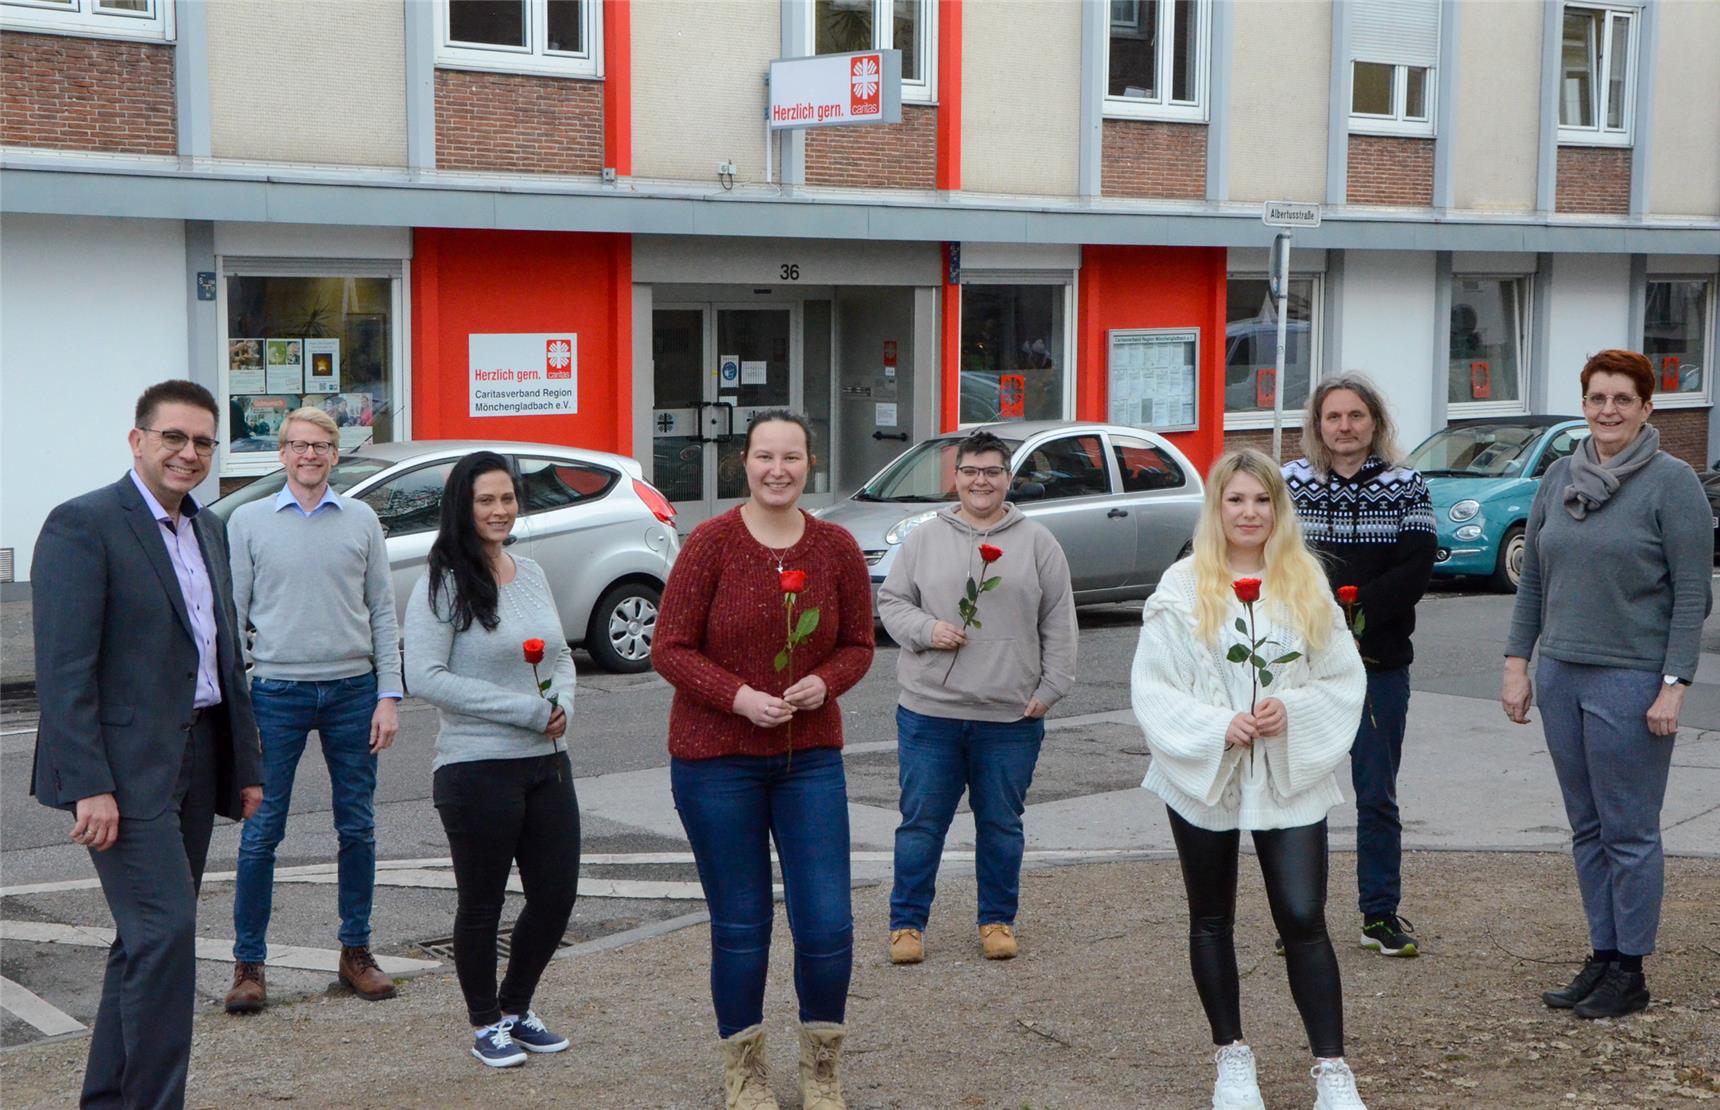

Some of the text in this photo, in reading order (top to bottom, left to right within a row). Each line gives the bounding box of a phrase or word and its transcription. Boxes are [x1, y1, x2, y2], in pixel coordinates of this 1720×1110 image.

[773, 102, 844, 121] Herzlich gern.
[851, 103, 877, 114] caritas
[1270, 209, 1314, 220] Albertusstraße
[780, 263, 799, 281] 36
[475, 369, 541, 382] Herzlich gern.
[475, 388, 572, 399] Caritasverband Region
[475, 401, 571, 412] Mönchengladbach e.V.
